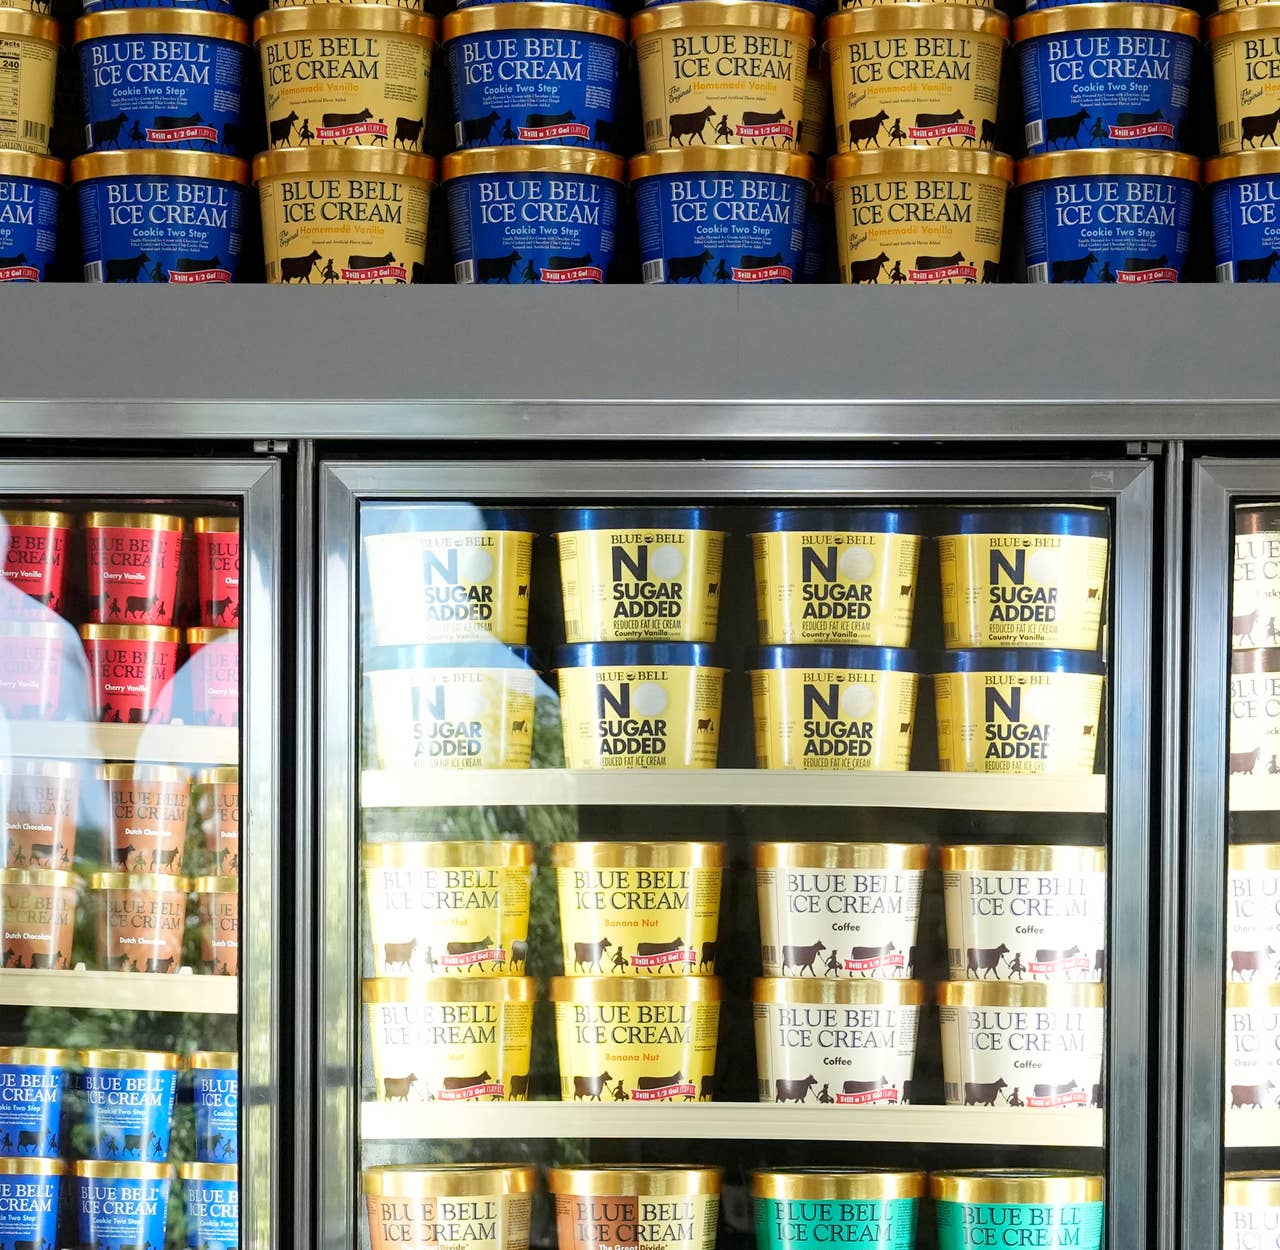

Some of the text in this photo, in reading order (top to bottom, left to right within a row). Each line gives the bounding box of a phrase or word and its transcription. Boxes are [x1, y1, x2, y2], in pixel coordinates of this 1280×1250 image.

[1240, 88, 1251, 99] The
[612, 534, 684, 544] BLUE BELL
[103, 572, 145, 580] Cherry Vanilla
[613, 582, 682, 600] SUGAR
[614, 600, 681, 618] ADDED
[614, 620, 681, 629] REDUCED FAT ICE CREAM
[614, 630, 642, 638] Country
[604, 919, 658, 927] Banana Nut
[832, 922, 861, 932] Coffee
[21, 1074, 58, 1088] BELL
[3, 1088, 56, 1102] CREAM
